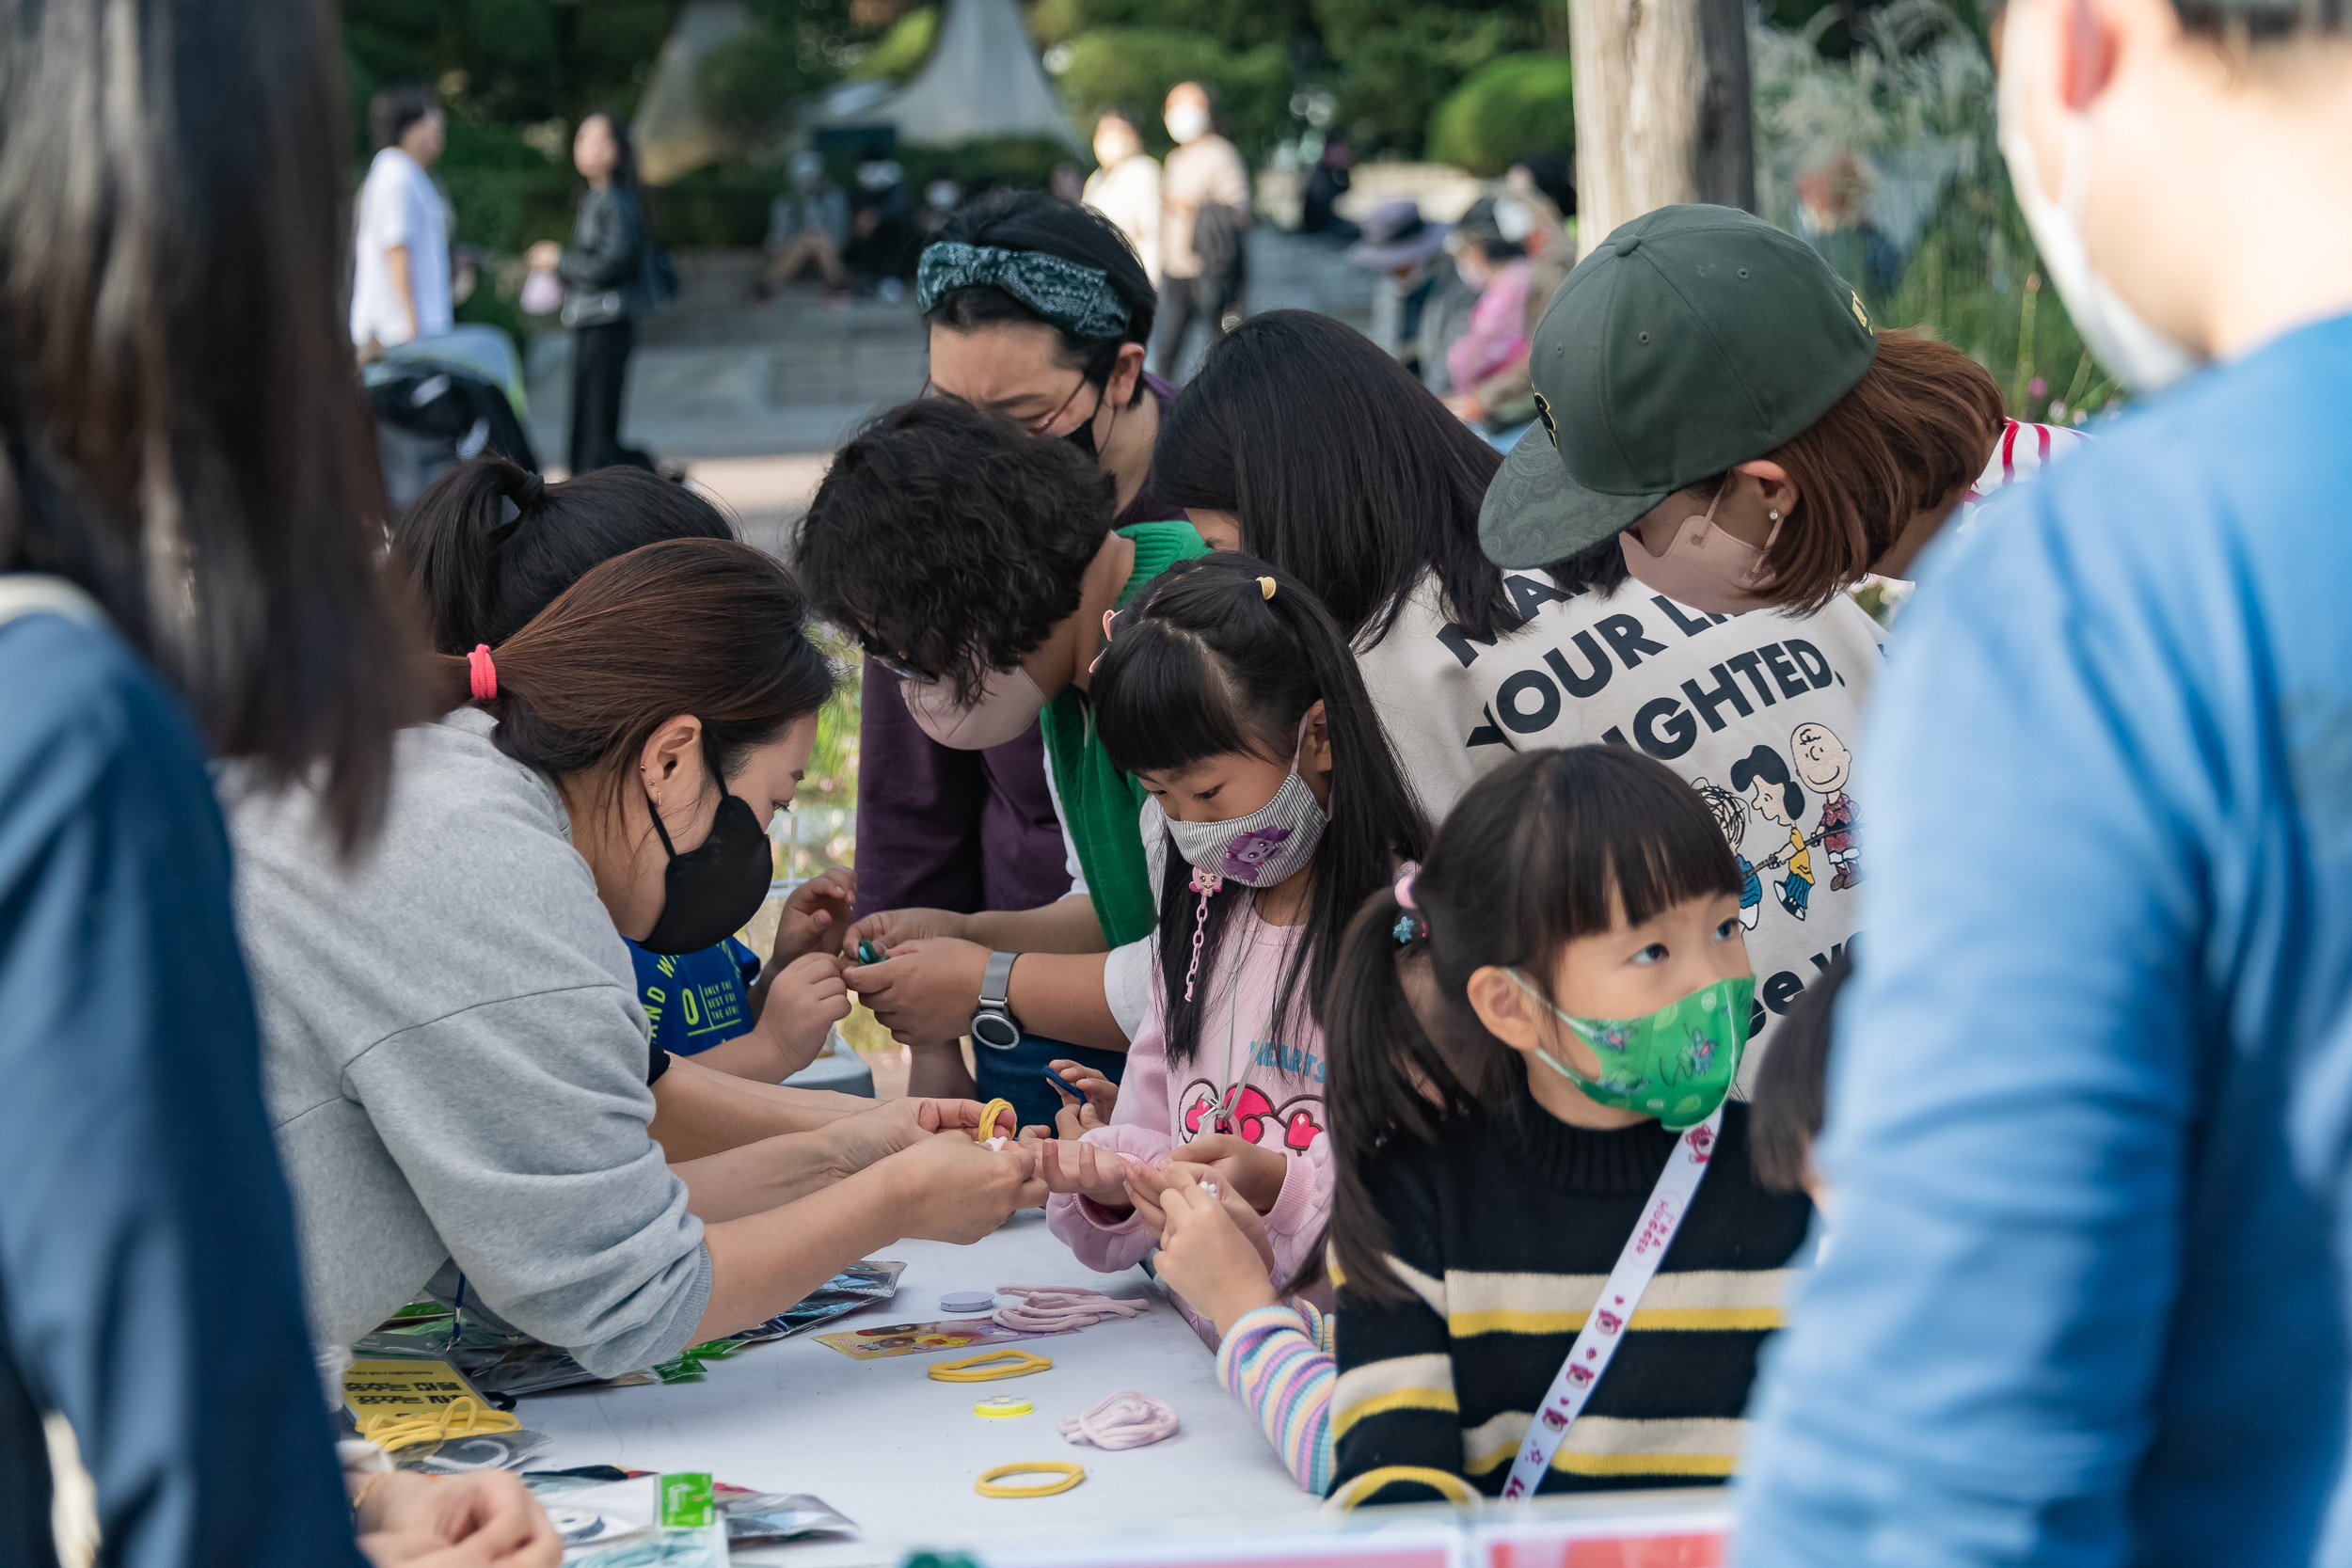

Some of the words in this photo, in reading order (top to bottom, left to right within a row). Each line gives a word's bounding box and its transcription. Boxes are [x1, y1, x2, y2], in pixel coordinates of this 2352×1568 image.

[1466, 613, 1669, 753] YOUR
[704, 984, 720, 996] ONLY
[707, 996, 724, 1008] BEST
